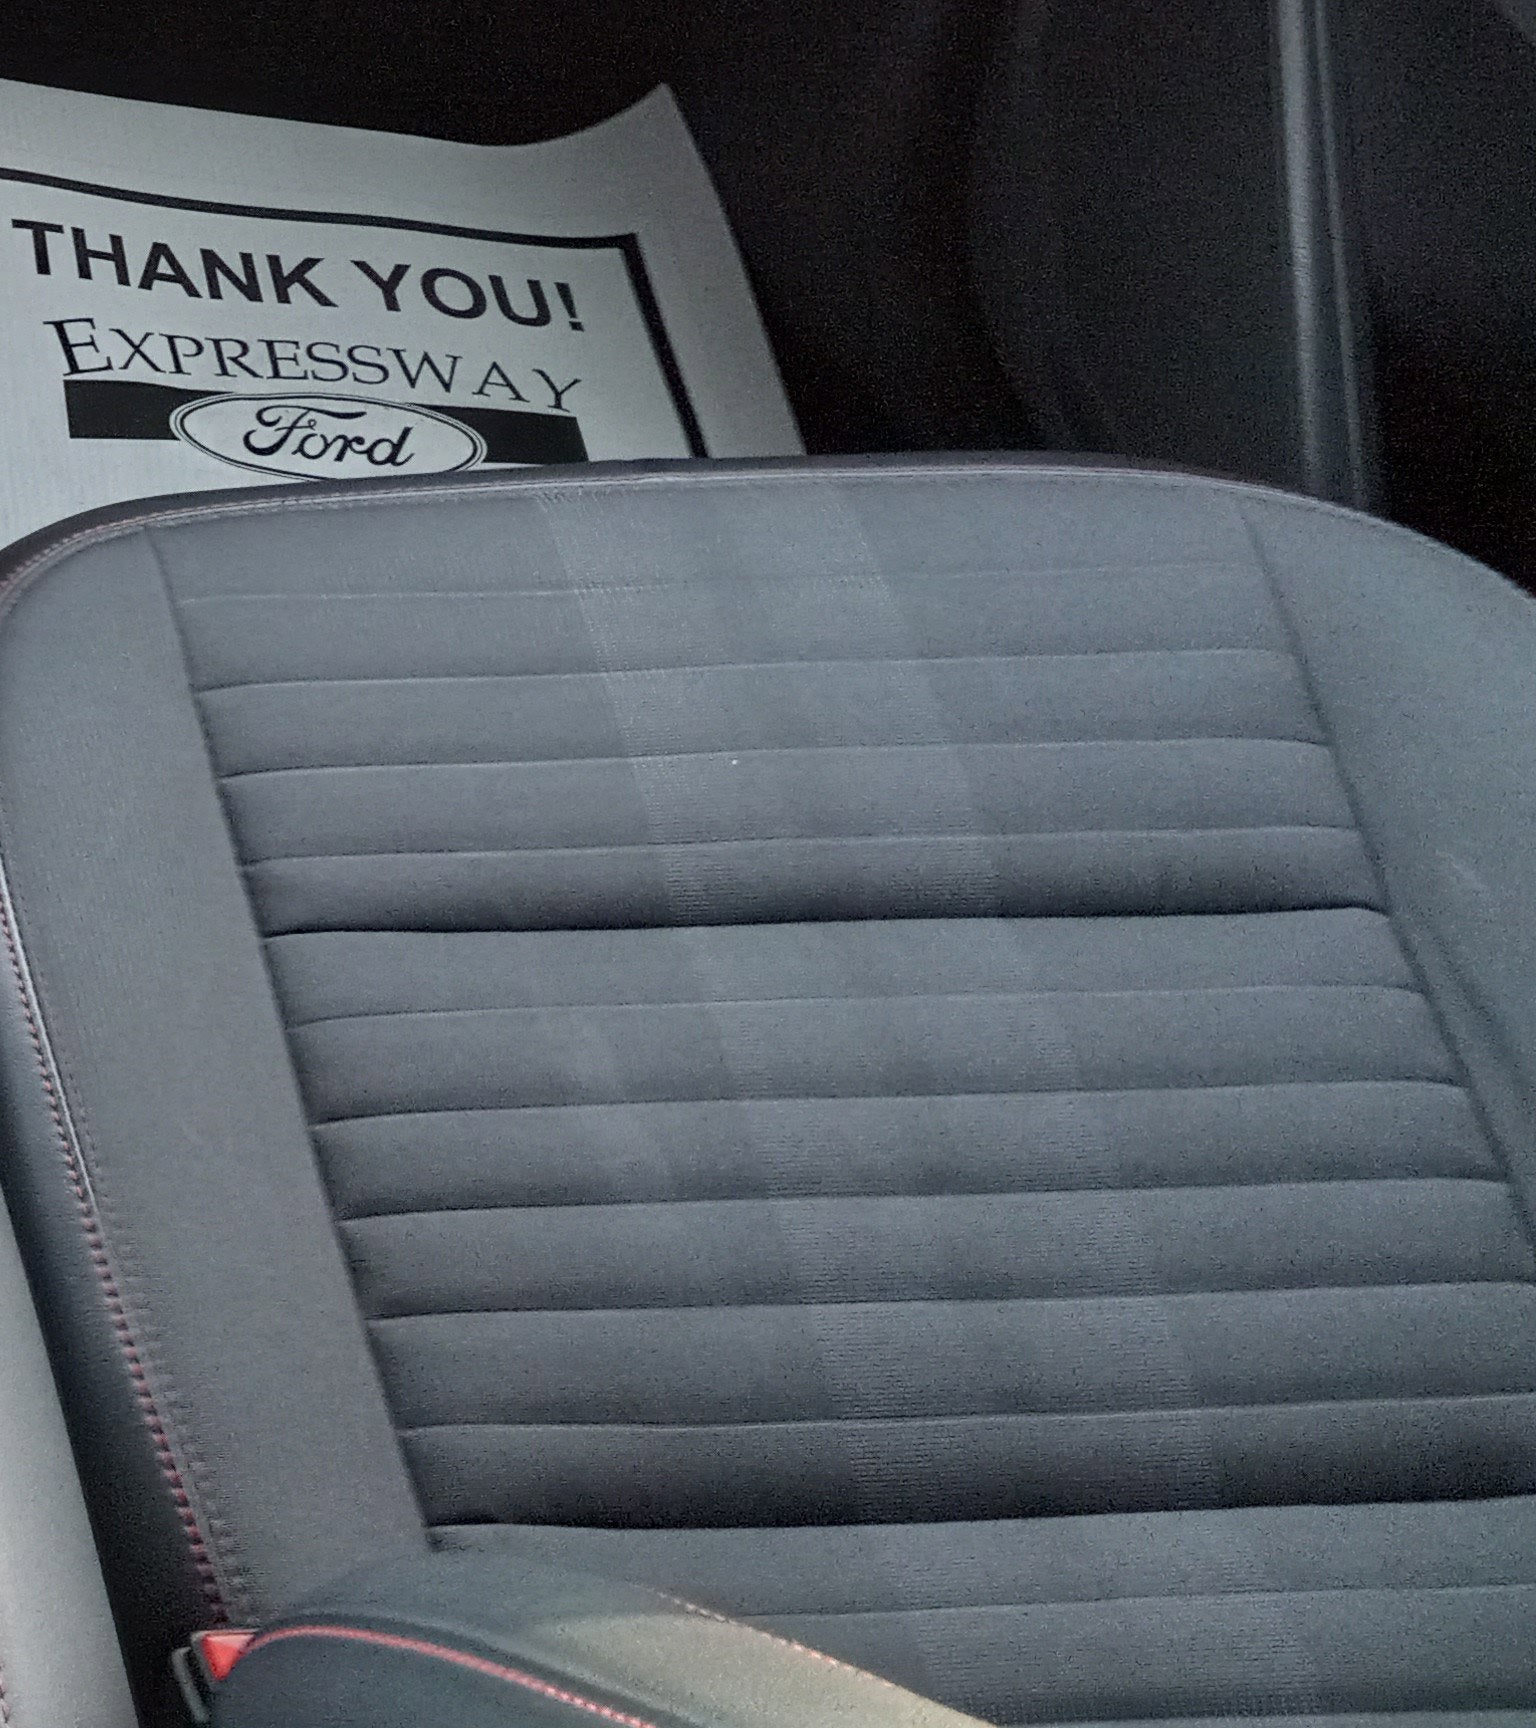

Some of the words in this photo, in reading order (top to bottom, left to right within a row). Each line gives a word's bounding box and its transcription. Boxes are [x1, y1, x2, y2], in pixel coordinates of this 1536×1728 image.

[11, 218, 339, 309] THANK
[351, 258, 586, 332] YOU!
[43, 317, 583, 413] EXPRESSWAY
[243, 403, 415, 468] Ford
